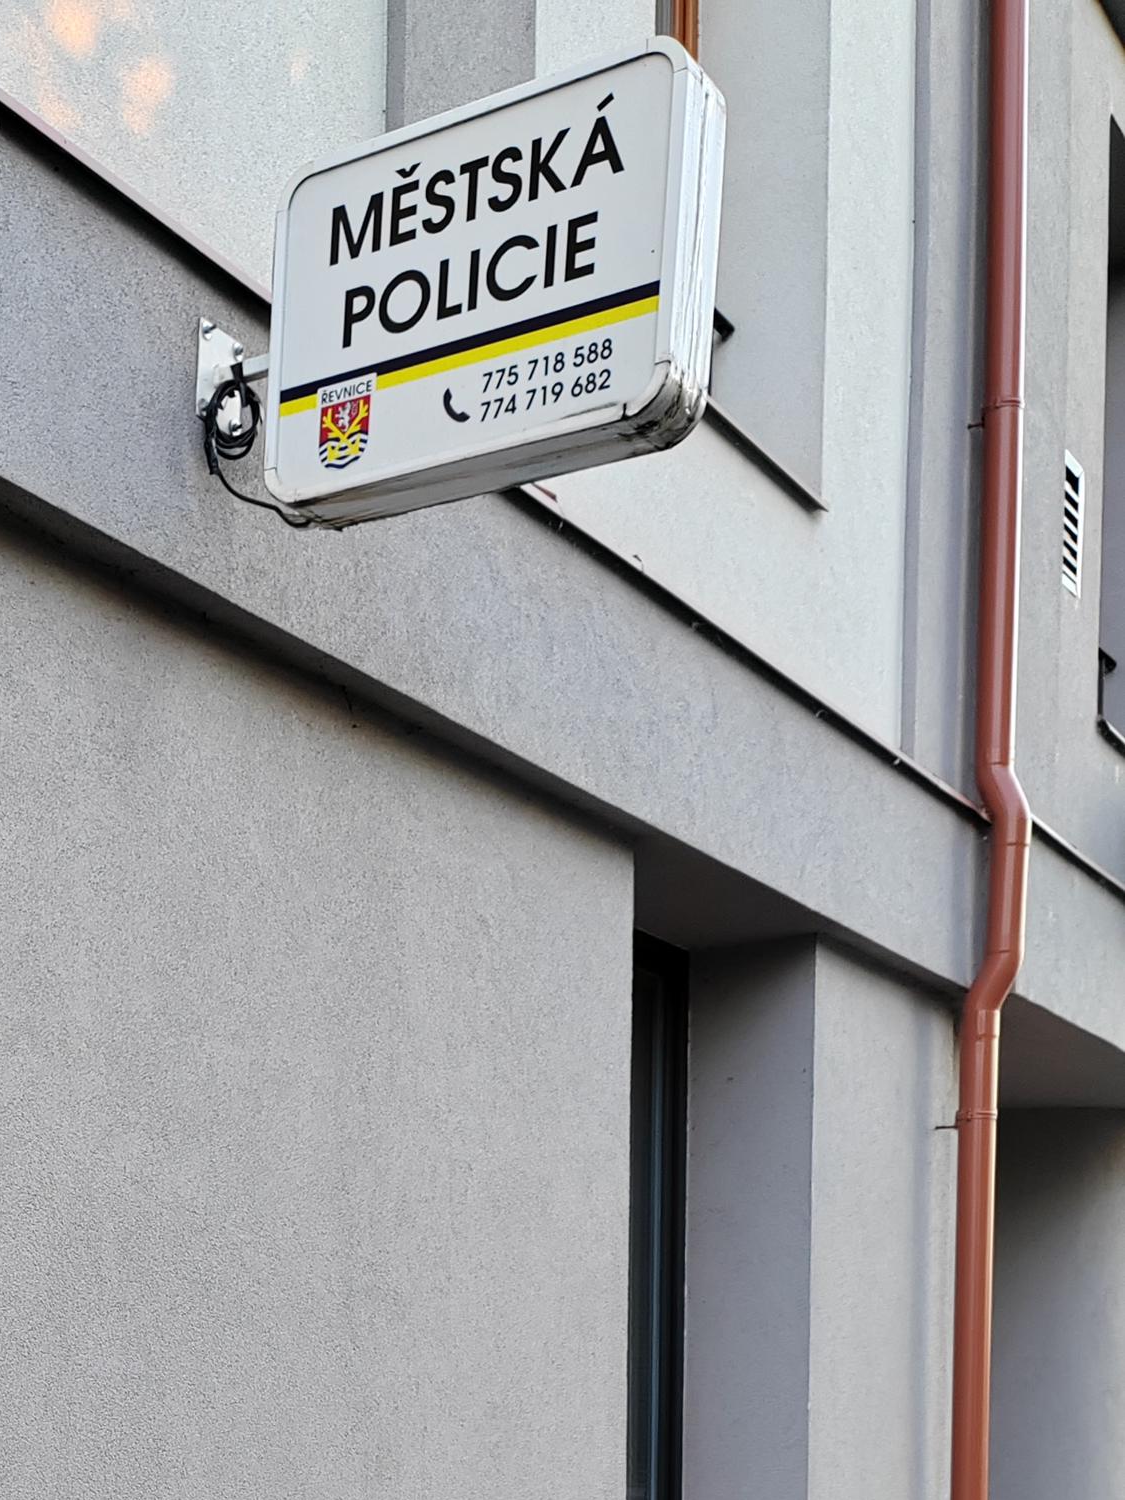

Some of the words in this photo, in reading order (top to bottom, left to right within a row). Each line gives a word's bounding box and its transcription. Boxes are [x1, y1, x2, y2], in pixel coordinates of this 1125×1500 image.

[329, 92, 625, 267] MĚSTSKÁ
[342, 211, 599, 348] POLICIE
[321, 380, 372, 405] ŘEVNICE
[483, 365, 519, 393] 775
[528, 352, 565, 381] 718
[573, 338, 612, 367] 588
[480, 394, 516, 422] 774
[526, 382, 563, 410] 719
[571, 369, 611, 397] 682
